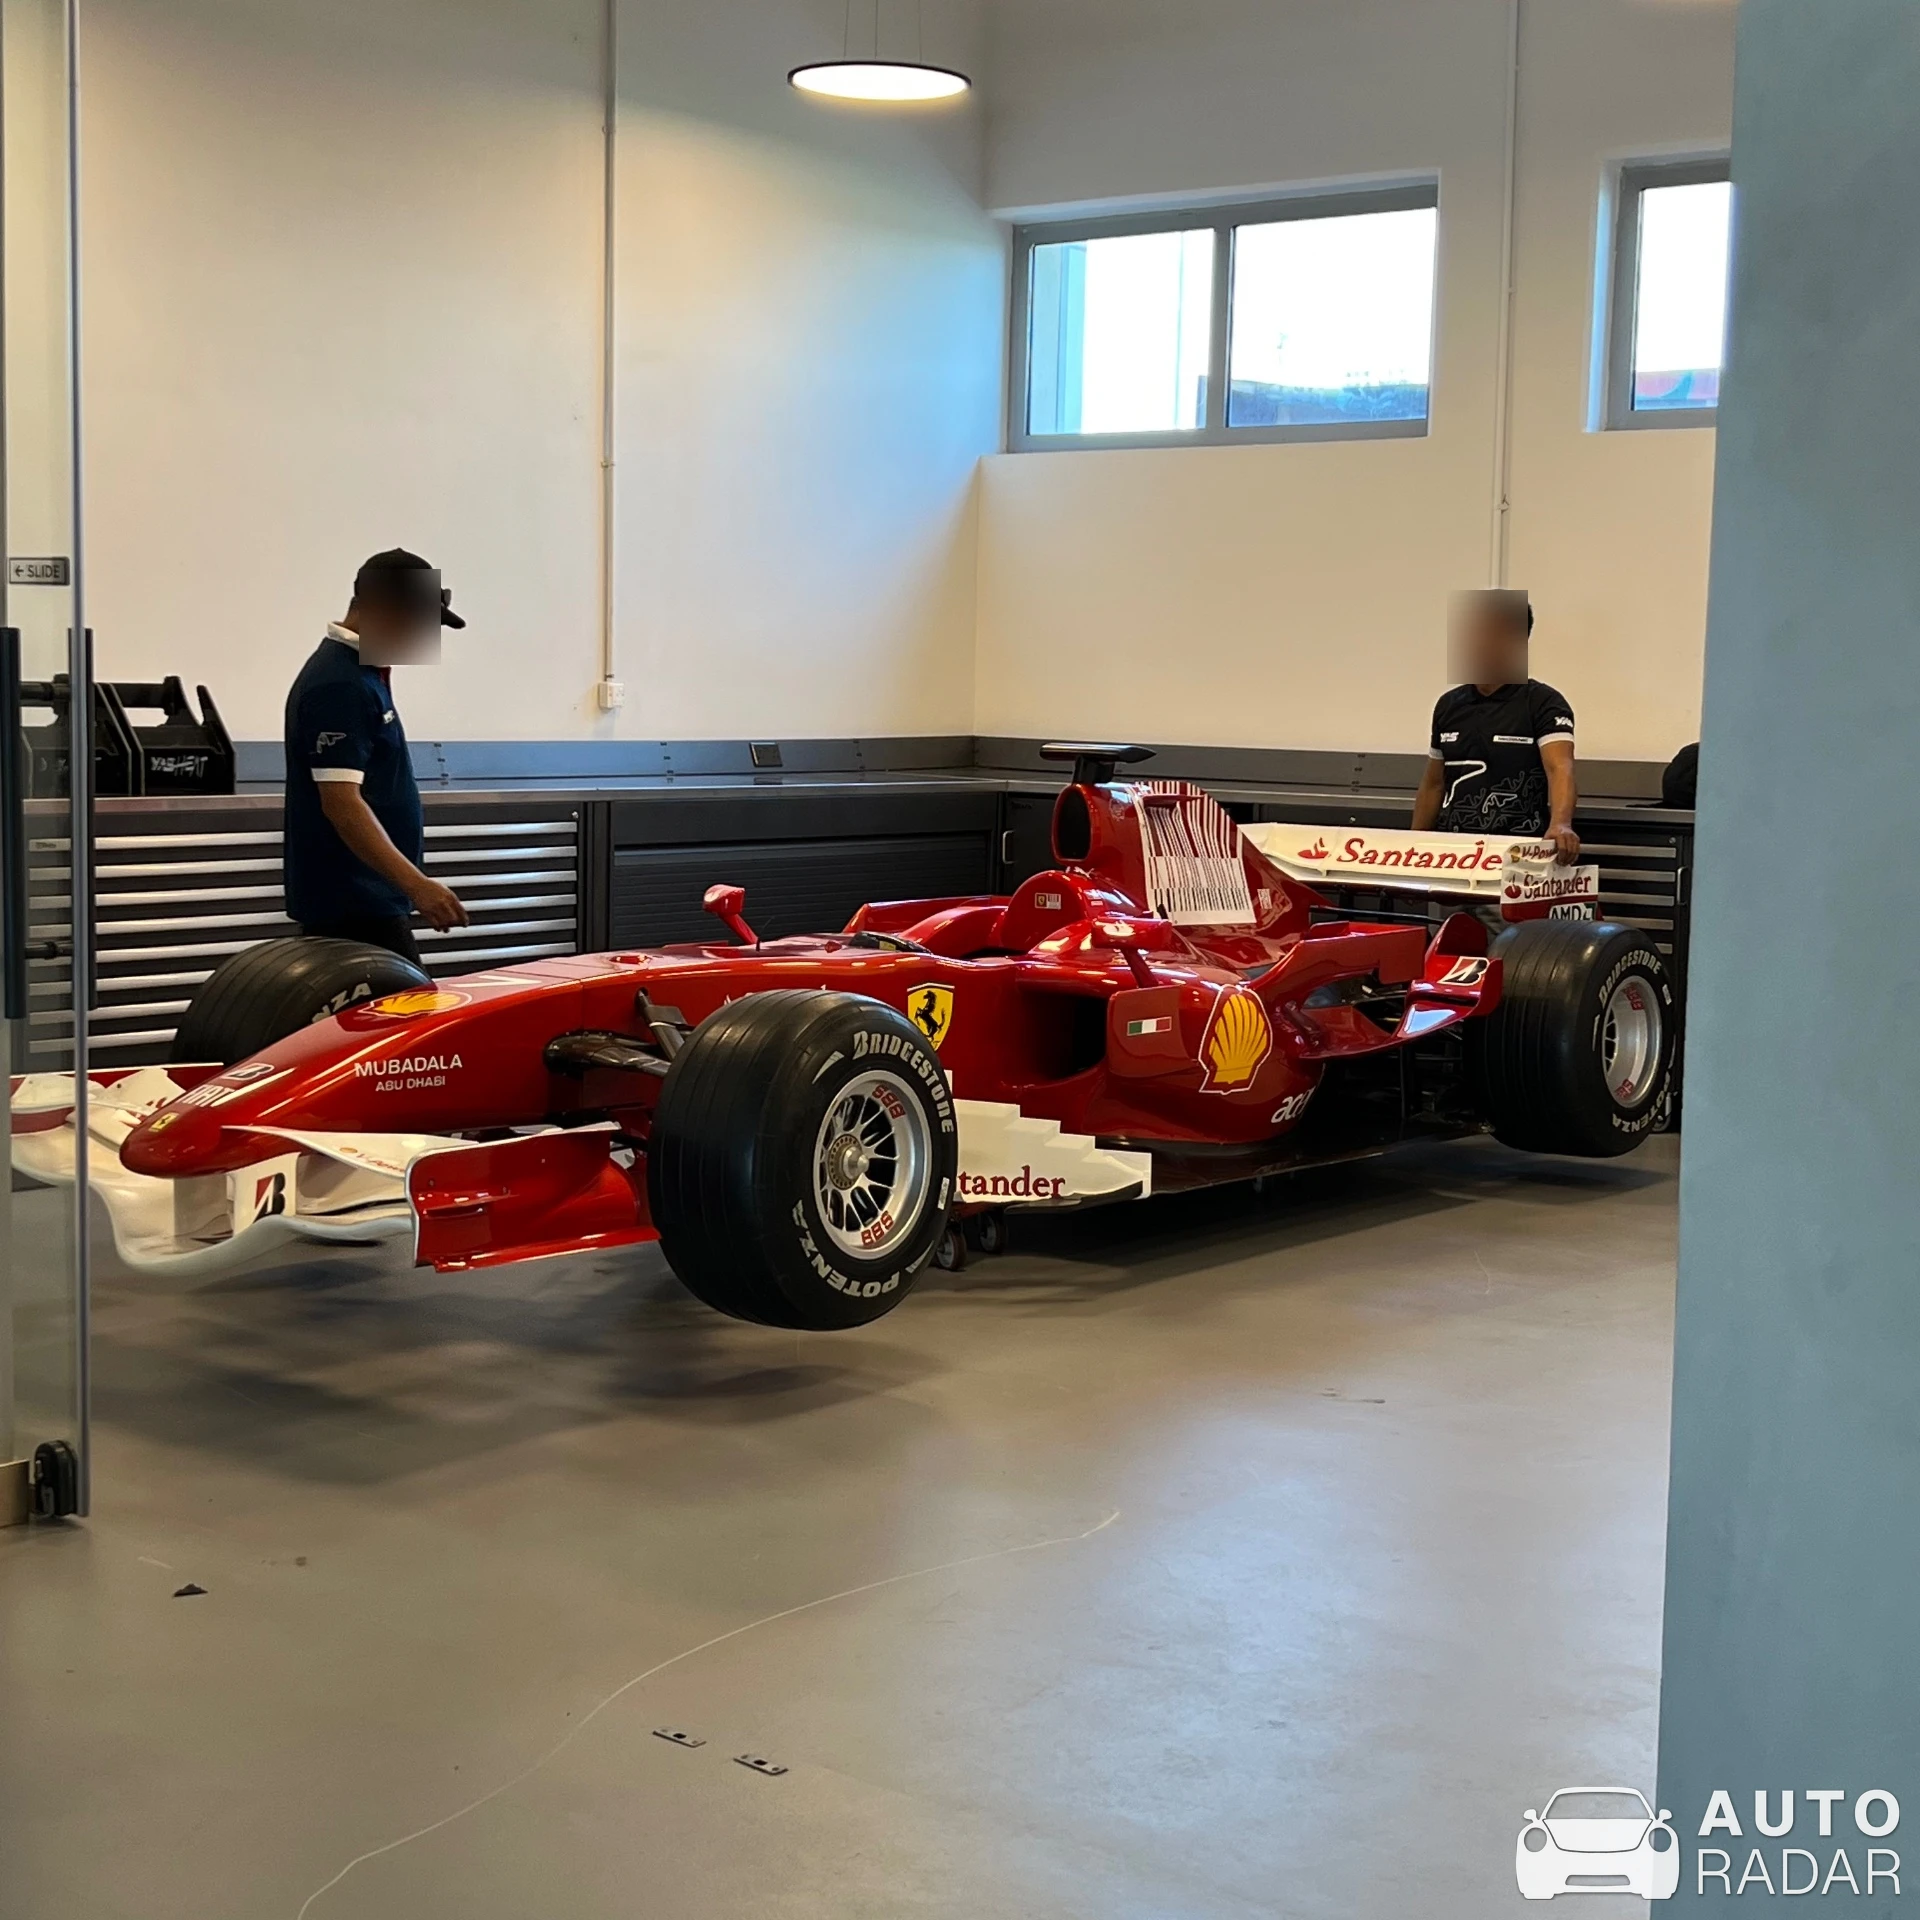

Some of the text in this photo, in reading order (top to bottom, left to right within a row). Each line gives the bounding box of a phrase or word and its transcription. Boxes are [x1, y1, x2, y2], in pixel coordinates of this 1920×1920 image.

[27, 564, 61, 579] SLIDE
[1336, 838, 1503, 871] Santande
[1523, 867, 1592, 901] Santander
[1551, 904, 1582, 920] AMD
[1598, 949, 1662, 1010] BRIDGESTONE
[354, 1054, 463, 1077] MUBADALA
[852, 1030, 954, 1134] BRIDGESTONE
[375, 1075, 446, 1092] ABU DHABI
[958, 1165, 1066, 1198] tander
[860, 1210, 895, 1248] BBS
[792, 1199, 900, 1298] POTENZA
